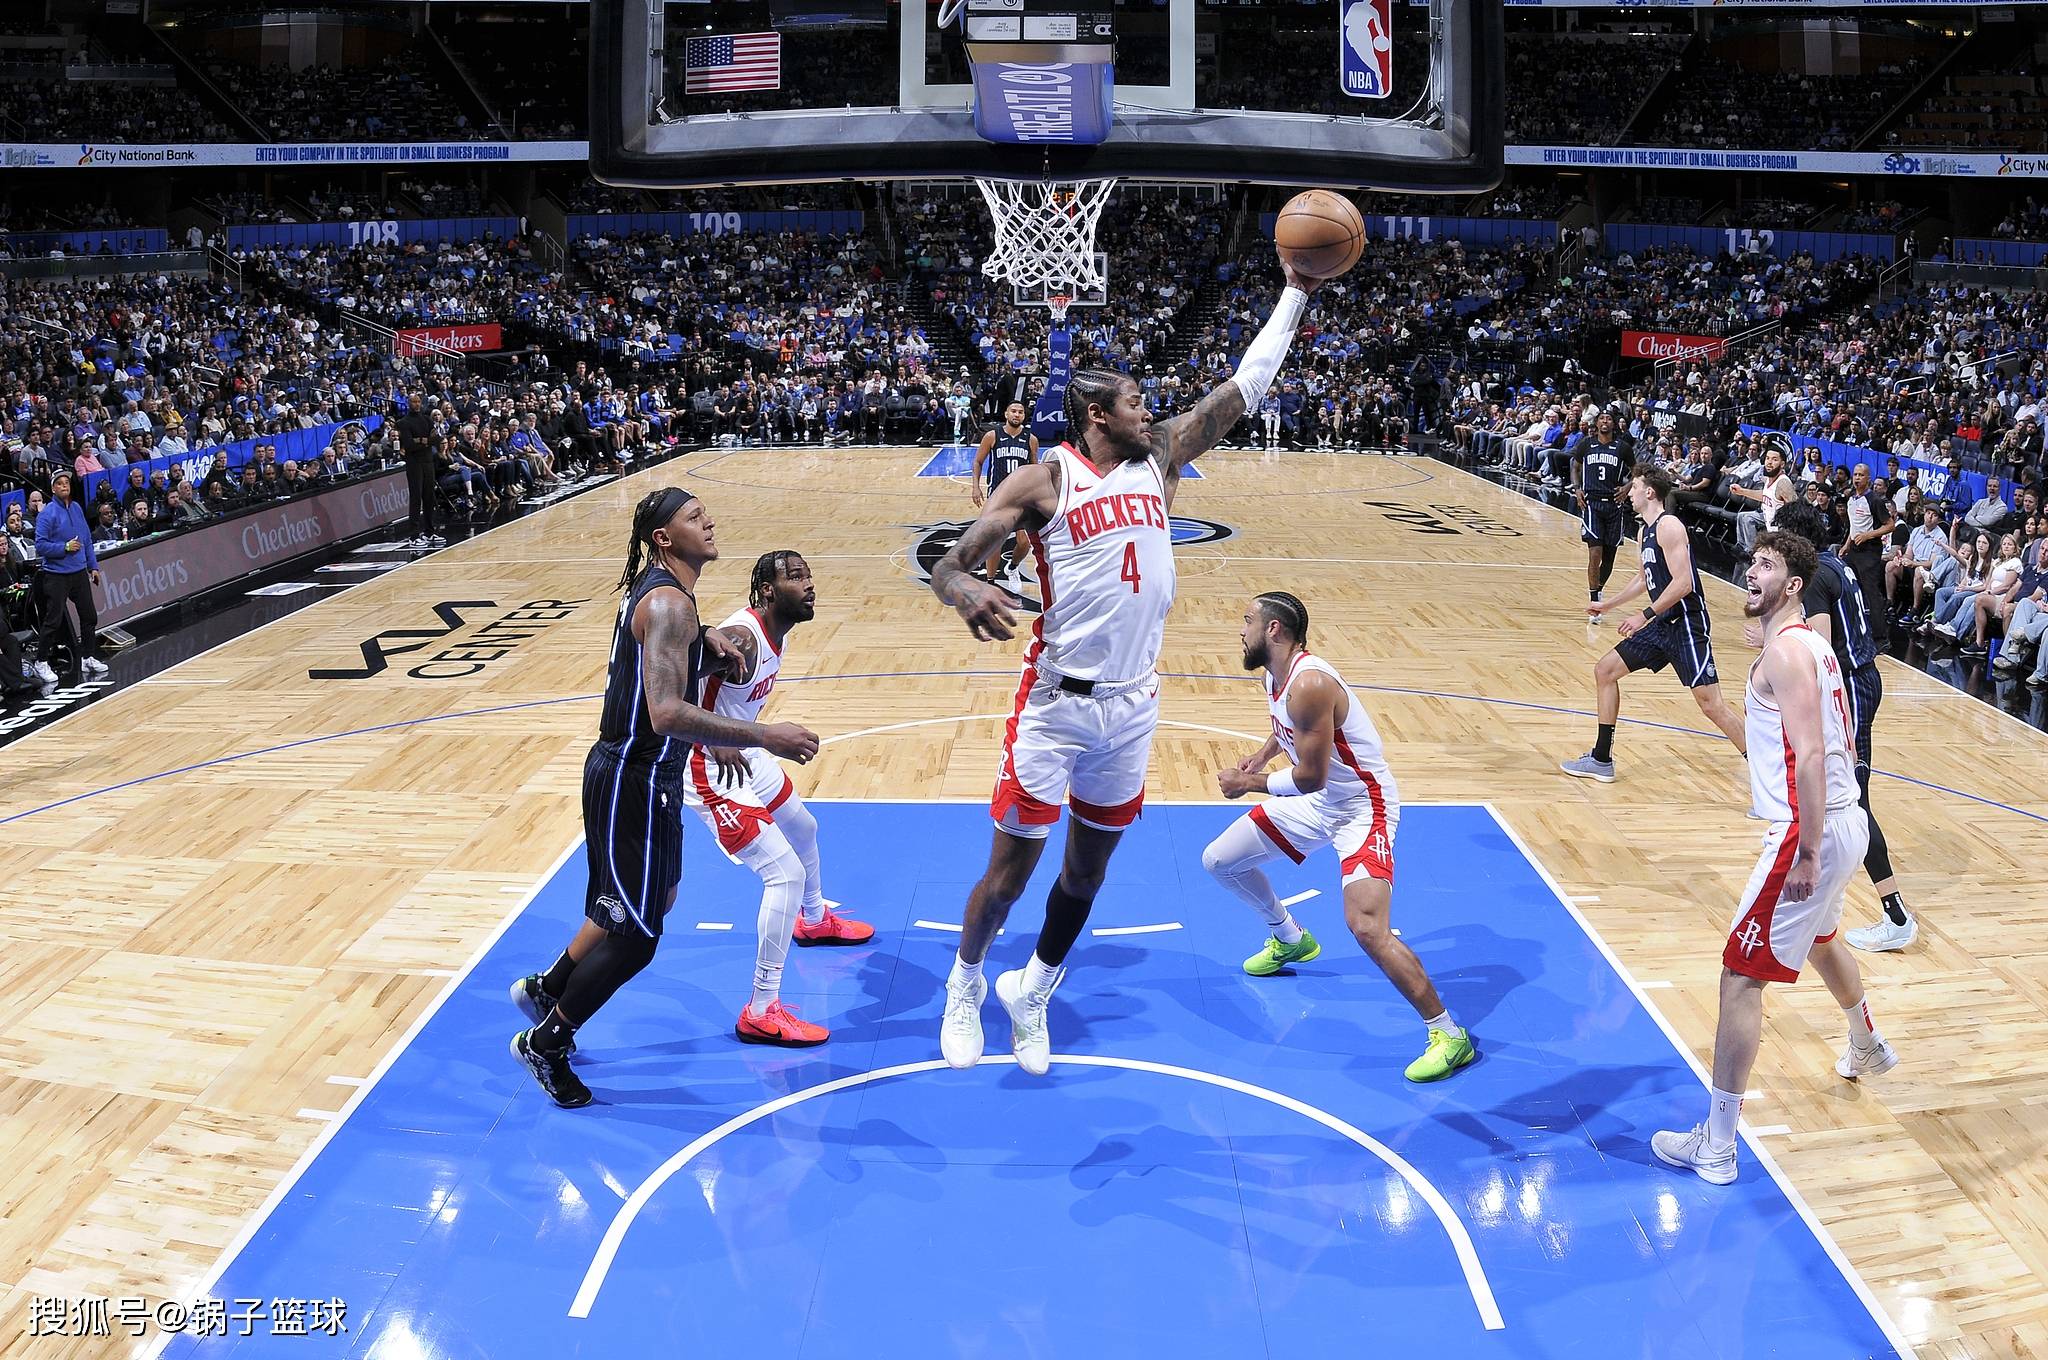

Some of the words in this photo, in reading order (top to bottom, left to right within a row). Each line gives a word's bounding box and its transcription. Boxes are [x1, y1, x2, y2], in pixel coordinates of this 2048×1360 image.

[1348, 70, 1373, 90] NBA
[94, 149, 117, 164] City
[119, 149, 164, 161] National
[166, 149, 195, 160] Bank
[255, 147, 277, 162] ENTER
[278, 147, 298, 162] YOUR
[299, 146, 336, 161] COMPANY
[336, 147, 345, 160] IN
[346, 146, 359, 160] THE
[360, 146, 398, 160] SPOTLIGHT
[399, 146, 410, 160] ON
[411, 146, 436, 160] SMALL
[436, 146, 473, 160] BUSINESS
[473, 146, 510, 160] PROGRAM
[1544, 149, 1567, 163] ENTER
[1567, 149, 1588, 163] YOUR
[1589, 150, 1624, 164] COMPANY
[1625, 151, 1633, 164] IN
[1634, 151, 1648, 165] THE
[1648, 151, 1687, 165] SPOTLIGHT
[1689, 152, 1700, 166] ON
[1700, 153, 1725, 167] SMALL
[1725, 154, 1761, 168] BUSINESS
[1762, 155, 1798, 169] PROGRAM
[2013, 160, 2036, 174] City
[348, 220, 399, 247] 108
[689, 212, 742, 239] 109
[1384, 215, 1433, 244] 111
[412, 330, 483, 352] Checkers
[996, 446, 1029, 460] ORLANDO
[1586, 453, 1619, 467] ORLANDO
[1006, 459, 1019, 474] 10
[1598, 466, 1606, 481] 3
[1066, 493, 1165, 546] ROCKETS
[242, 512, 322, 559] Checkers
[1120, 541, 1142, 594] 4
[407, 598, 592, 679] CENTER
